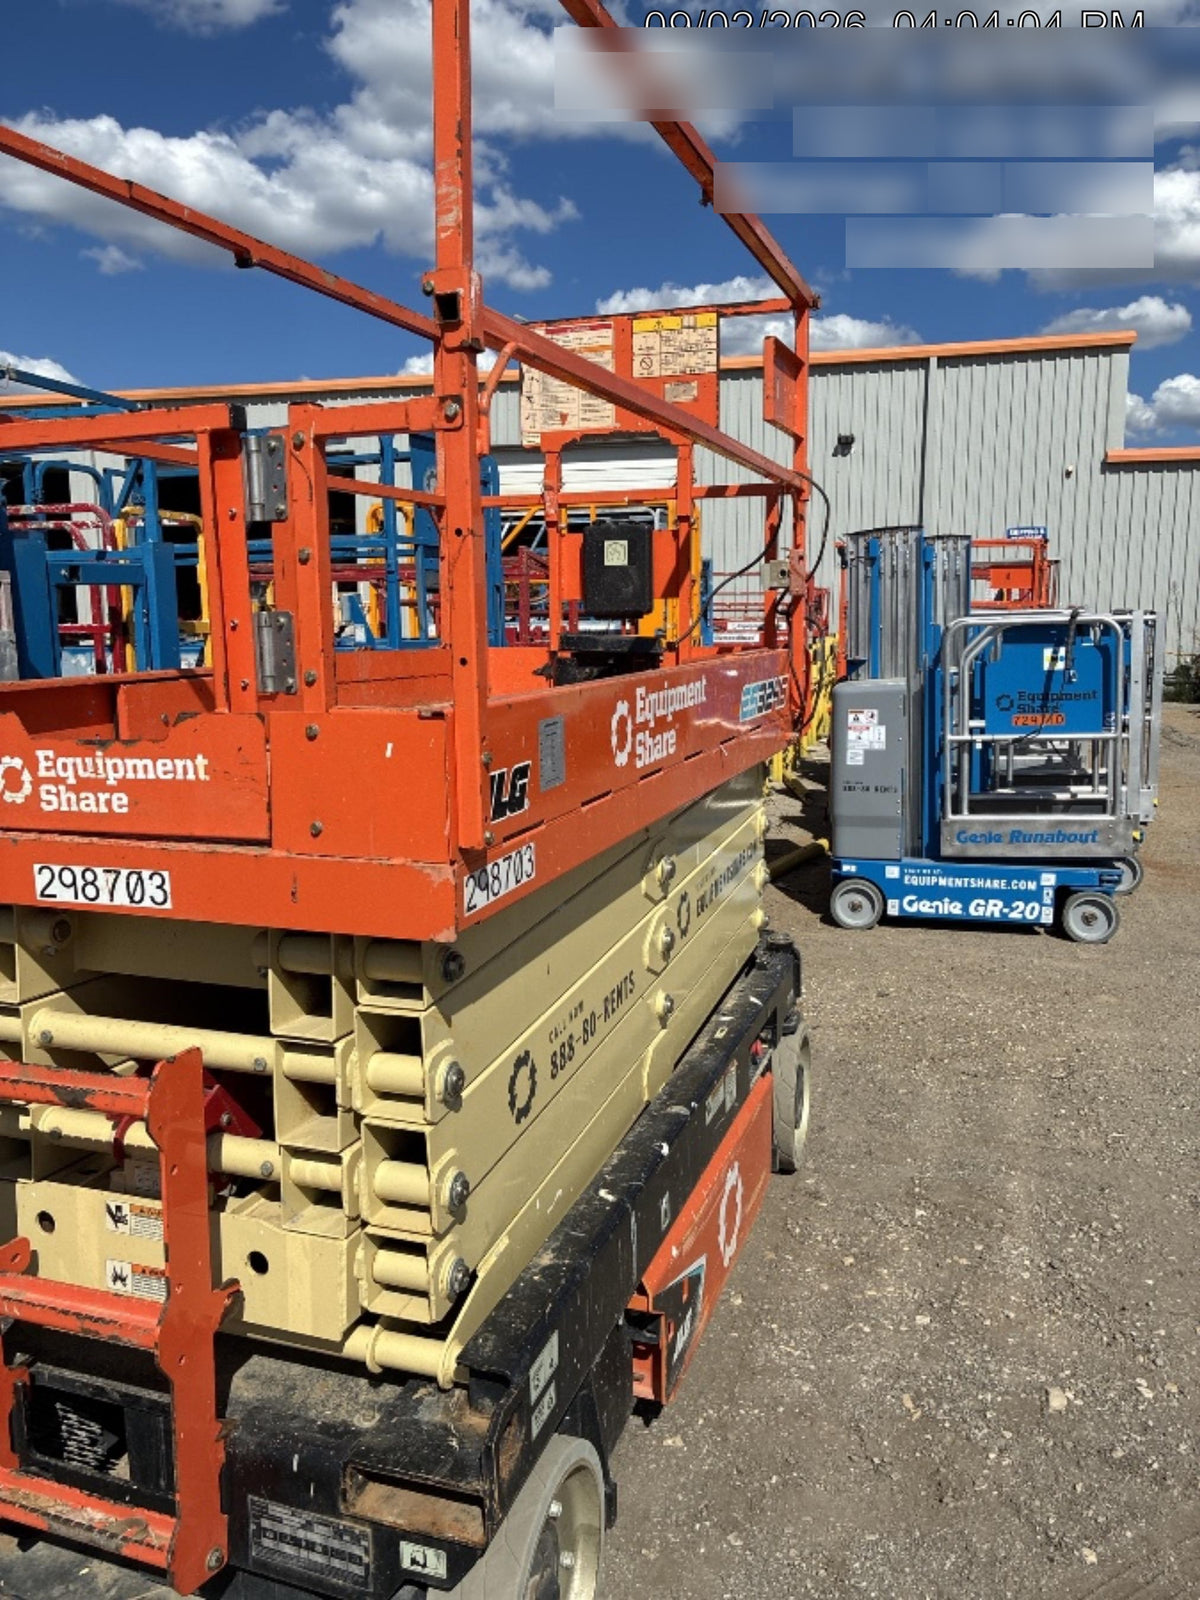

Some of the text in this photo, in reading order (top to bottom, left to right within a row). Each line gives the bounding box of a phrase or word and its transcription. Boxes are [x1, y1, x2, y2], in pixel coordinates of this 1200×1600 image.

[636, 675, 706, 727] Equipment
[1017, 703, 1059, 714] Shae
[1018, 689, 1097, 702] Equpment
[636, 728, 676, 768] Share
[35, 750, 210, 785] Equipment
[39, 784, 129, 813] Share
[490, 761, 532, 824] LG
[956, 829, 1099, 844] Genie Runabout
[37, 865, 169, 906] 298703
[465, 845, 534, 913] 298703
[903, 875, 1038, 891] EQUIPMENTSHARE.COM
[902, 894, 1041, 920] Genie GR-20
